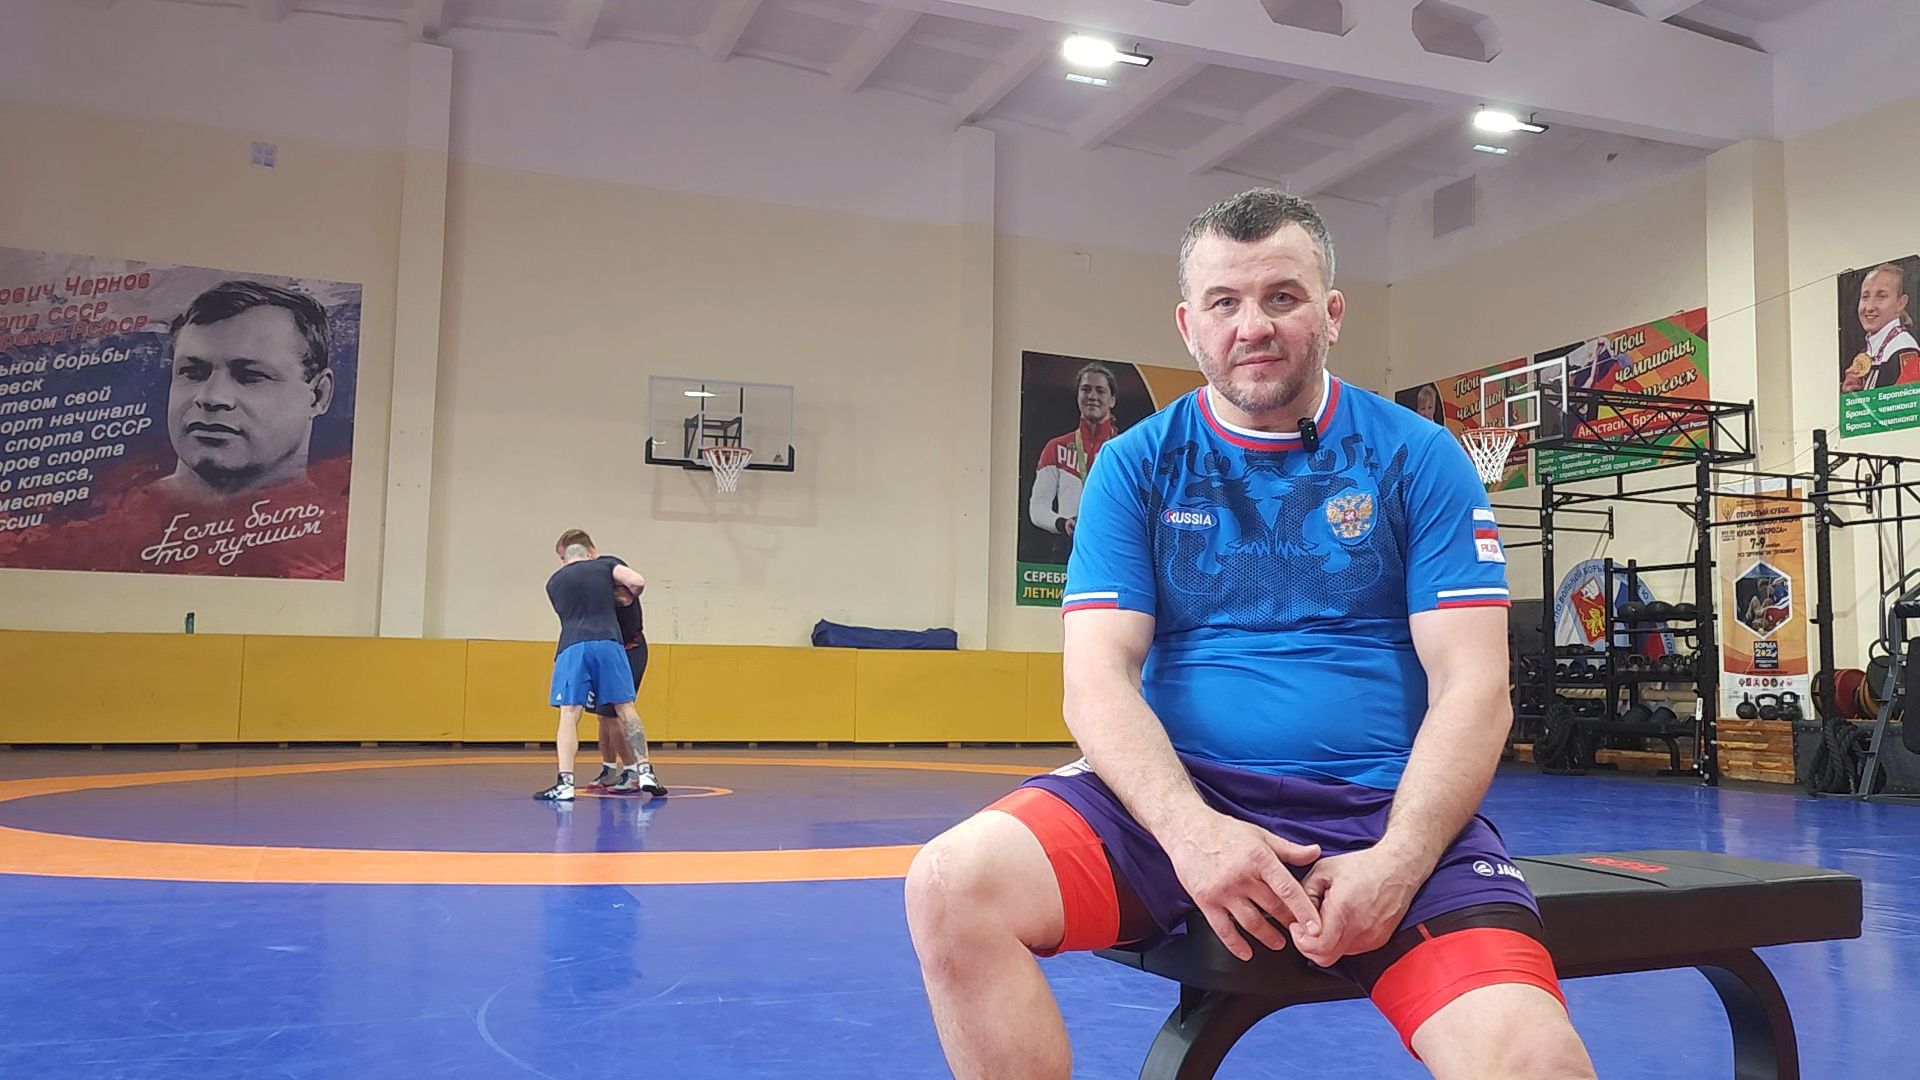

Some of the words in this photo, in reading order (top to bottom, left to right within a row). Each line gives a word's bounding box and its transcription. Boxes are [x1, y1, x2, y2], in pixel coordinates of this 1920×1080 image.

[0, 284, 56, 305] ович
[65, 272, 150, 299] Чернов
[48, 301, 108, 325] СССР
[71, 315, 148, 341] РСФСР
[1611, 330, 1645, 357] Твои
[53, 346, 130, 371] борьбы
[1615, 338, 1697, 383] чемпионы,
[64, 385, 112, 407] свой
[49, 402, 148, 428] начинали
[5, 430, 84, 453] спорта
[91, 417, 152, 441] СССР
[0, 456, 40, 477] ров
[47, 443, 125, 466] спорта
[17, 467, 94, 491] класса,
[141, 513, 235, 560] Если
[245, 499, 326, 529] быть,
[1165, 511, 1212, 526] RUSSIA
[155, 544, 199, 566] то
[208, 519, 322, 566] лучшим
[1750, 537, 1766, 550] 7-9
